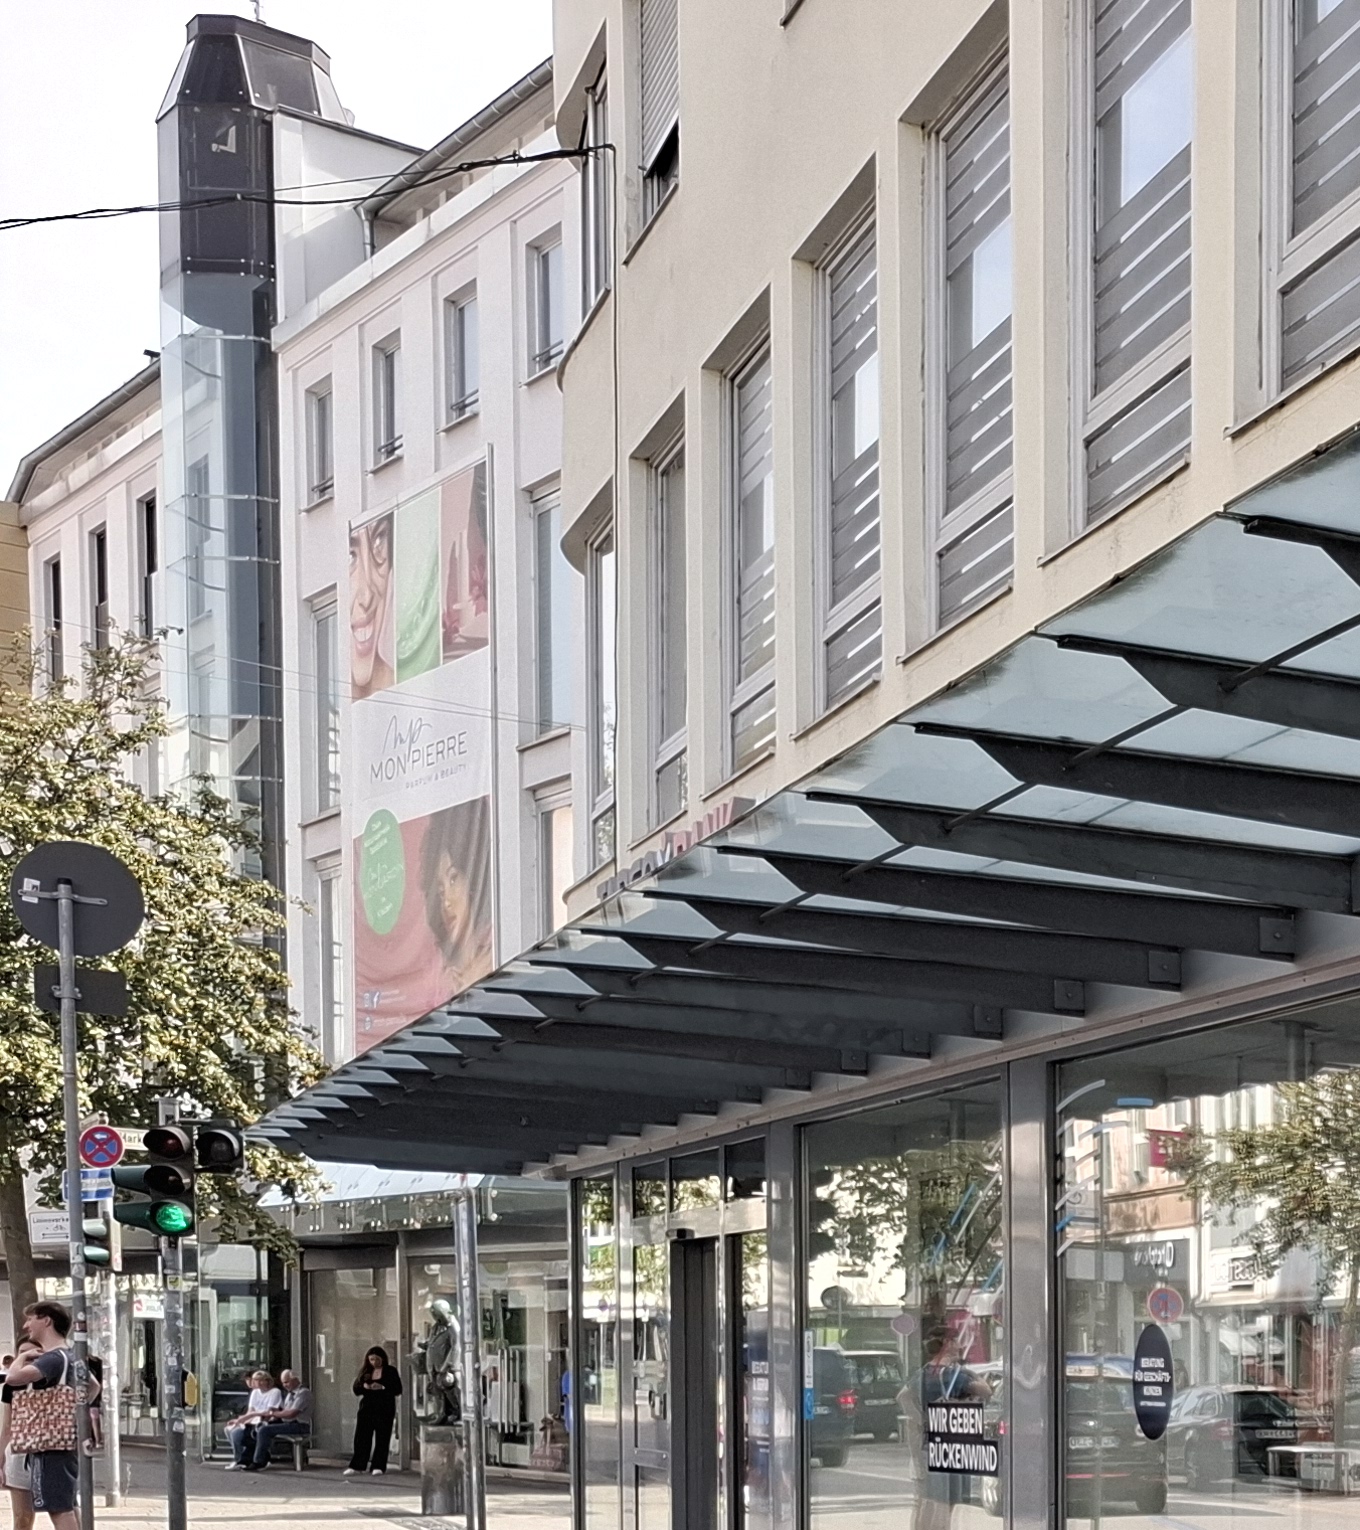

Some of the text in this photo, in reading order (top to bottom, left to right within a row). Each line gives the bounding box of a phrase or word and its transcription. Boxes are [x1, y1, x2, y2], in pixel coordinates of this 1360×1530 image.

[370, 731, 468, 784] MON PIERRE
[928, 1407, 983, 1434] WIR GEBEN
[929, 1436, 998, 1472] RÜCKENWIND
